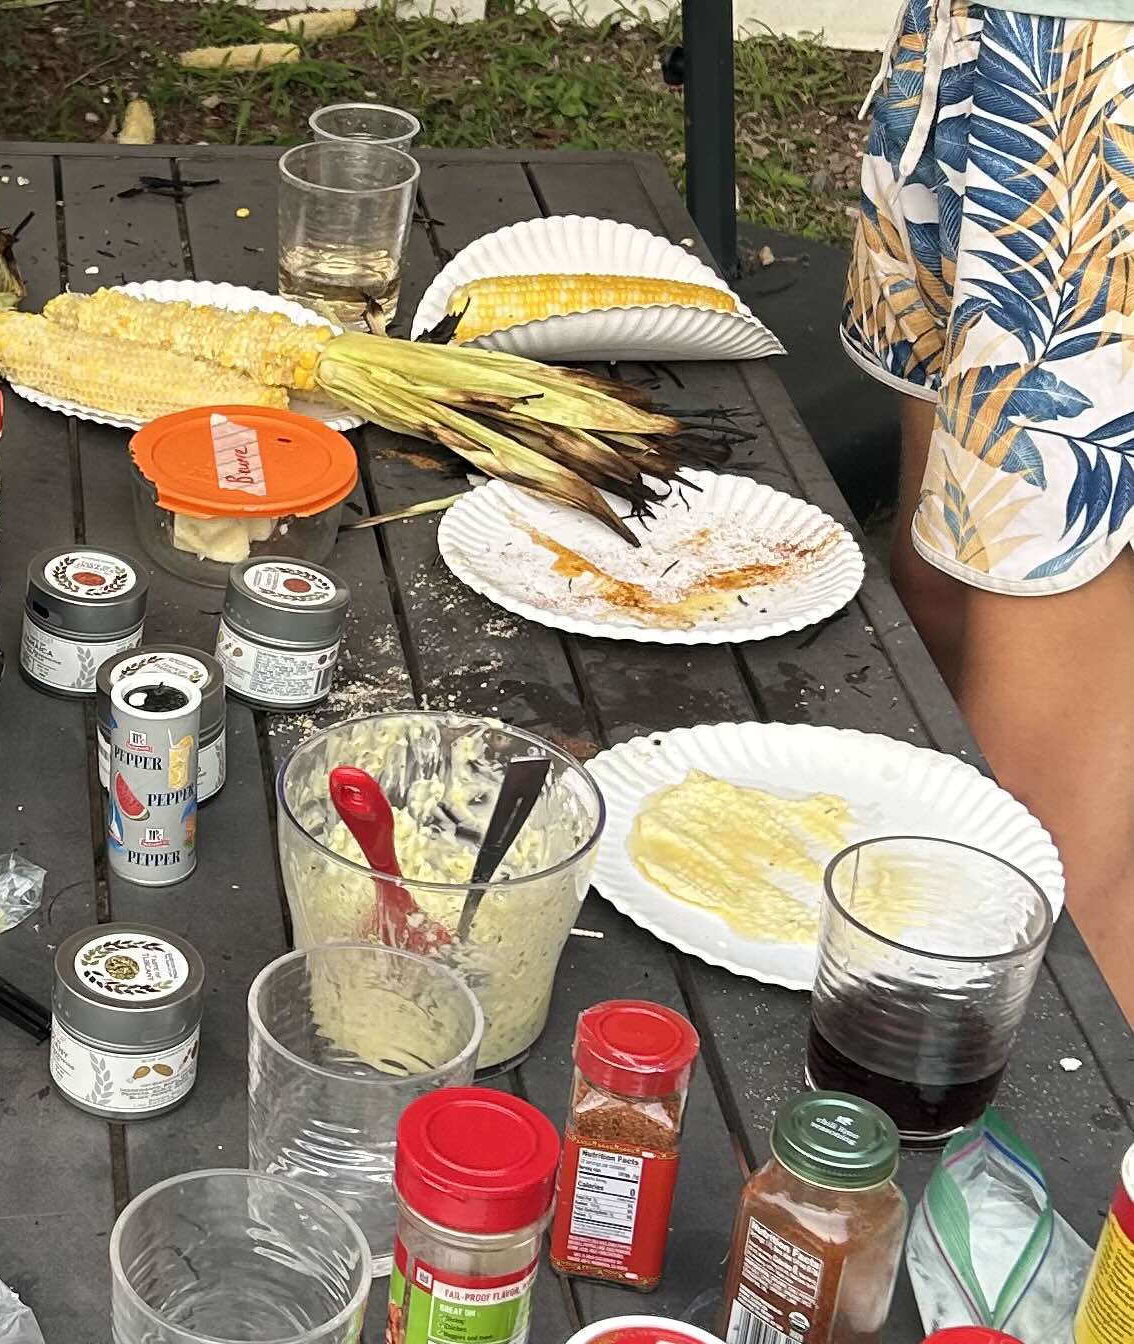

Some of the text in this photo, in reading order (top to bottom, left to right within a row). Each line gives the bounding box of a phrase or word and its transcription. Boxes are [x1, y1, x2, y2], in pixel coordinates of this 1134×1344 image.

[114, 745, 162, 770] PEPPER
[147, 783, 194, 806] PEPPER
[128, 850, 180, 866] PEPPER
[582, 1150, 639, 1166] Nutrition Facts
